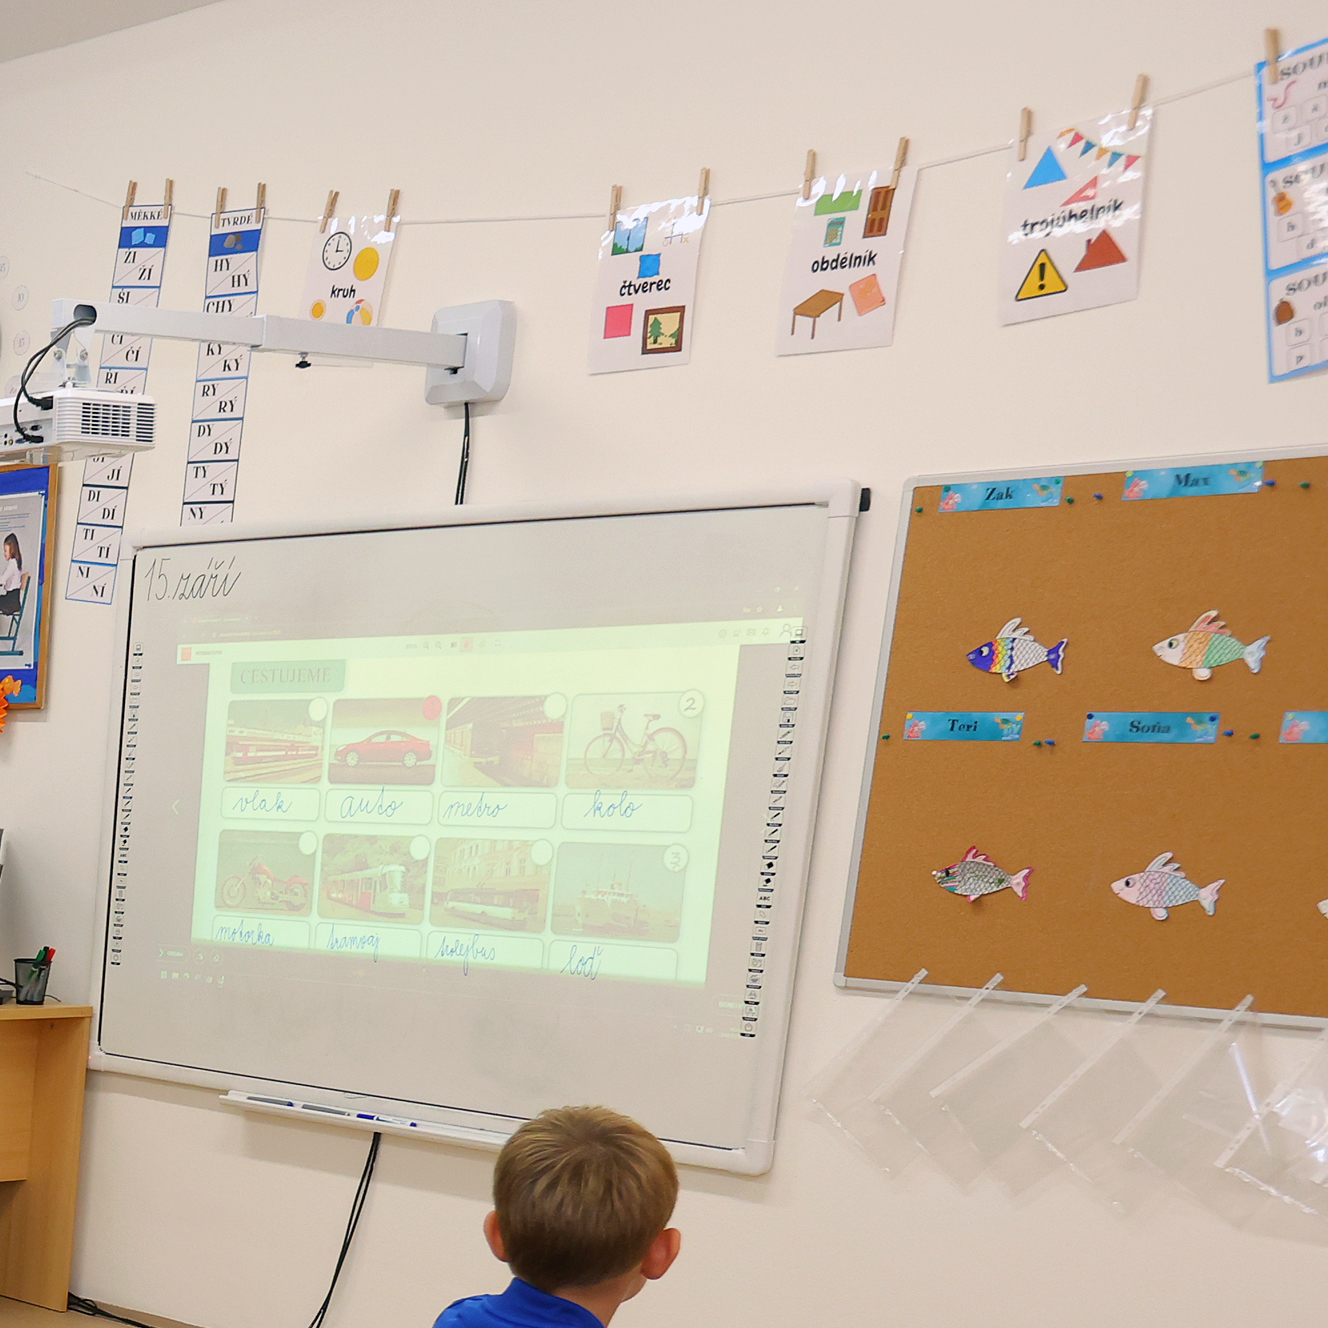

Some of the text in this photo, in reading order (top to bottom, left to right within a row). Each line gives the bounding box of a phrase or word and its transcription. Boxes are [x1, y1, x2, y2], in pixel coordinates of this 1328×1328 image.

[1280, 52, 1328, 81] SOU
[130, 208, 163, 221] MĚKKÉ
[221, 214, 253, 227] TVRDÉ
[124, 247, 137, 264] ŽI
[811, 250, 877, 273] obdélník
[214, 258, 232, 272] HY
[138, 265, 154, 281] ŽÍ
[231, 270, 250, 288] HÝ
[330, 285, 356, 298] kruh
[619, 277, 671, 297] čtverec
[207, 300, 234, 313] CHY
[125, 347, 141, 362] ČÍ
[207, 342, 224, 356] KY
[223, 355, 243, 372] KÝ
[202, 384, 219, 397] RY
[218, 397, 237, 413] RÝ
[197, 424, 214, 438] DY
[214, 438, 232, 455] DÝ
[107, 466, 123, 481] JÍ
[194, 466, 209, 478] TY
[210, 479, 227, 496] TÝ
[984, 487, 1014, 501] Zak
[88, 490, 100, 502] DI
[102, 506, 117, 520] DÍ
[188, 507, 206, 520] NY
[83, 528, 94, 541] TI
[97, 544, 112, 559] TÍ
[77, 566, 90, 579] NI
[144, 556, 241, 601] 15. září
[93, 583, 106, 598] NÍ
[241, 668, 331, 684] CESTUJEME
[684, 697, 696, 711] 2
[233, 790, 292, 812] vlak
[340, 786, 404, 818] auto
[443, 792, 508, 819] metro
[583, 790, 643, 817] kolo
[216, 920, 274, 946] motorka
[327, 923, 381, 962] tramvaj
[435, 934, 495, 977] trolejbus
[561, 945, 603, 980] loď
